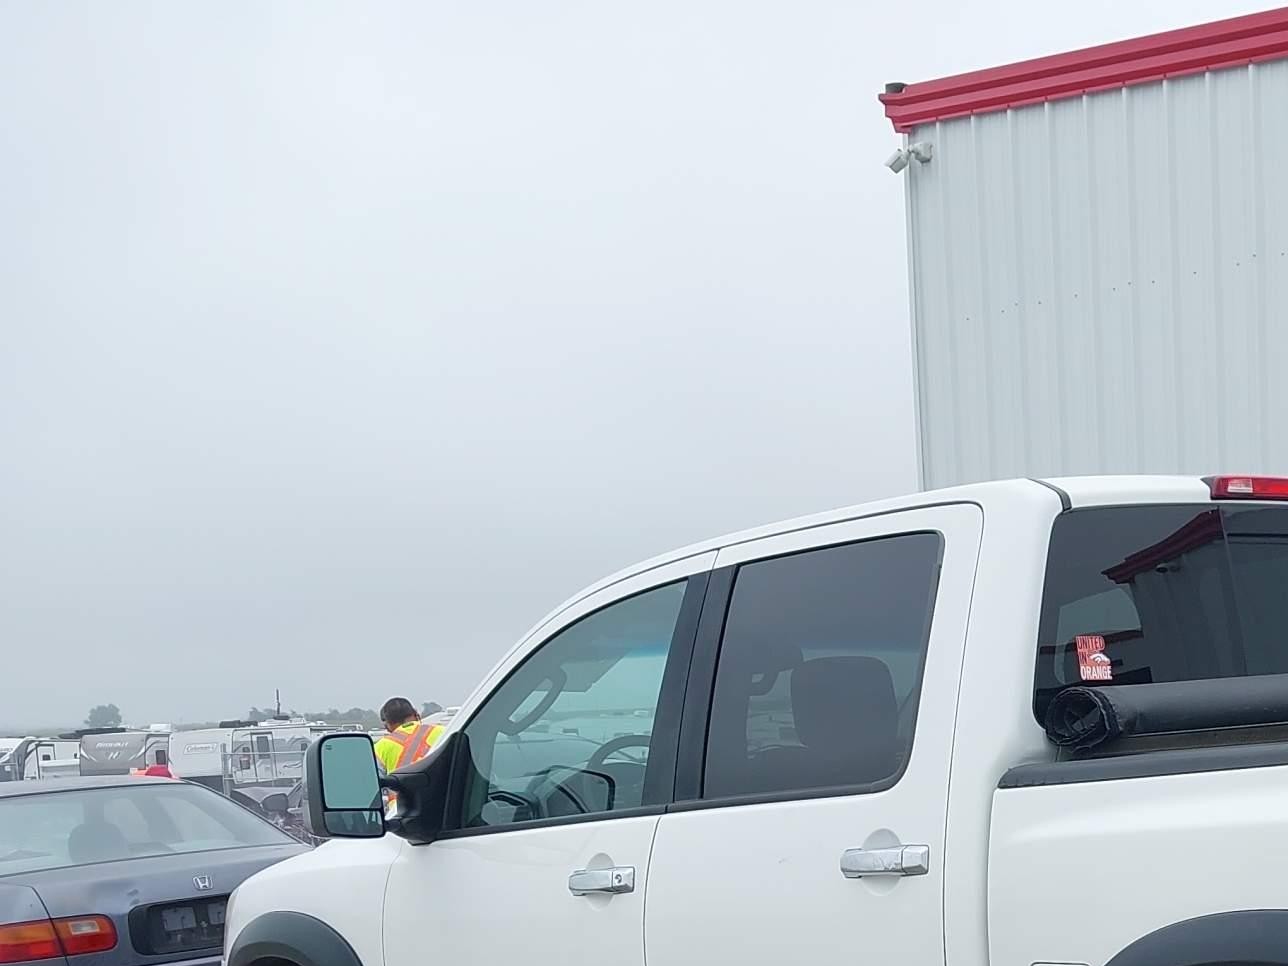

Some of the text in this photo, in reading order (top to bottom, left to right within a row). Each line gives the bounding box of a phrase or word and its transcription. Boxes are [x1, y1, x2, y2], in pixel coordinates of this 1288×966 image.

[1077, 636, 1105, 650] UNITED
[1079, 651, 1088, 665] IN
[1081, 665, 1113, 680] ORANGE
